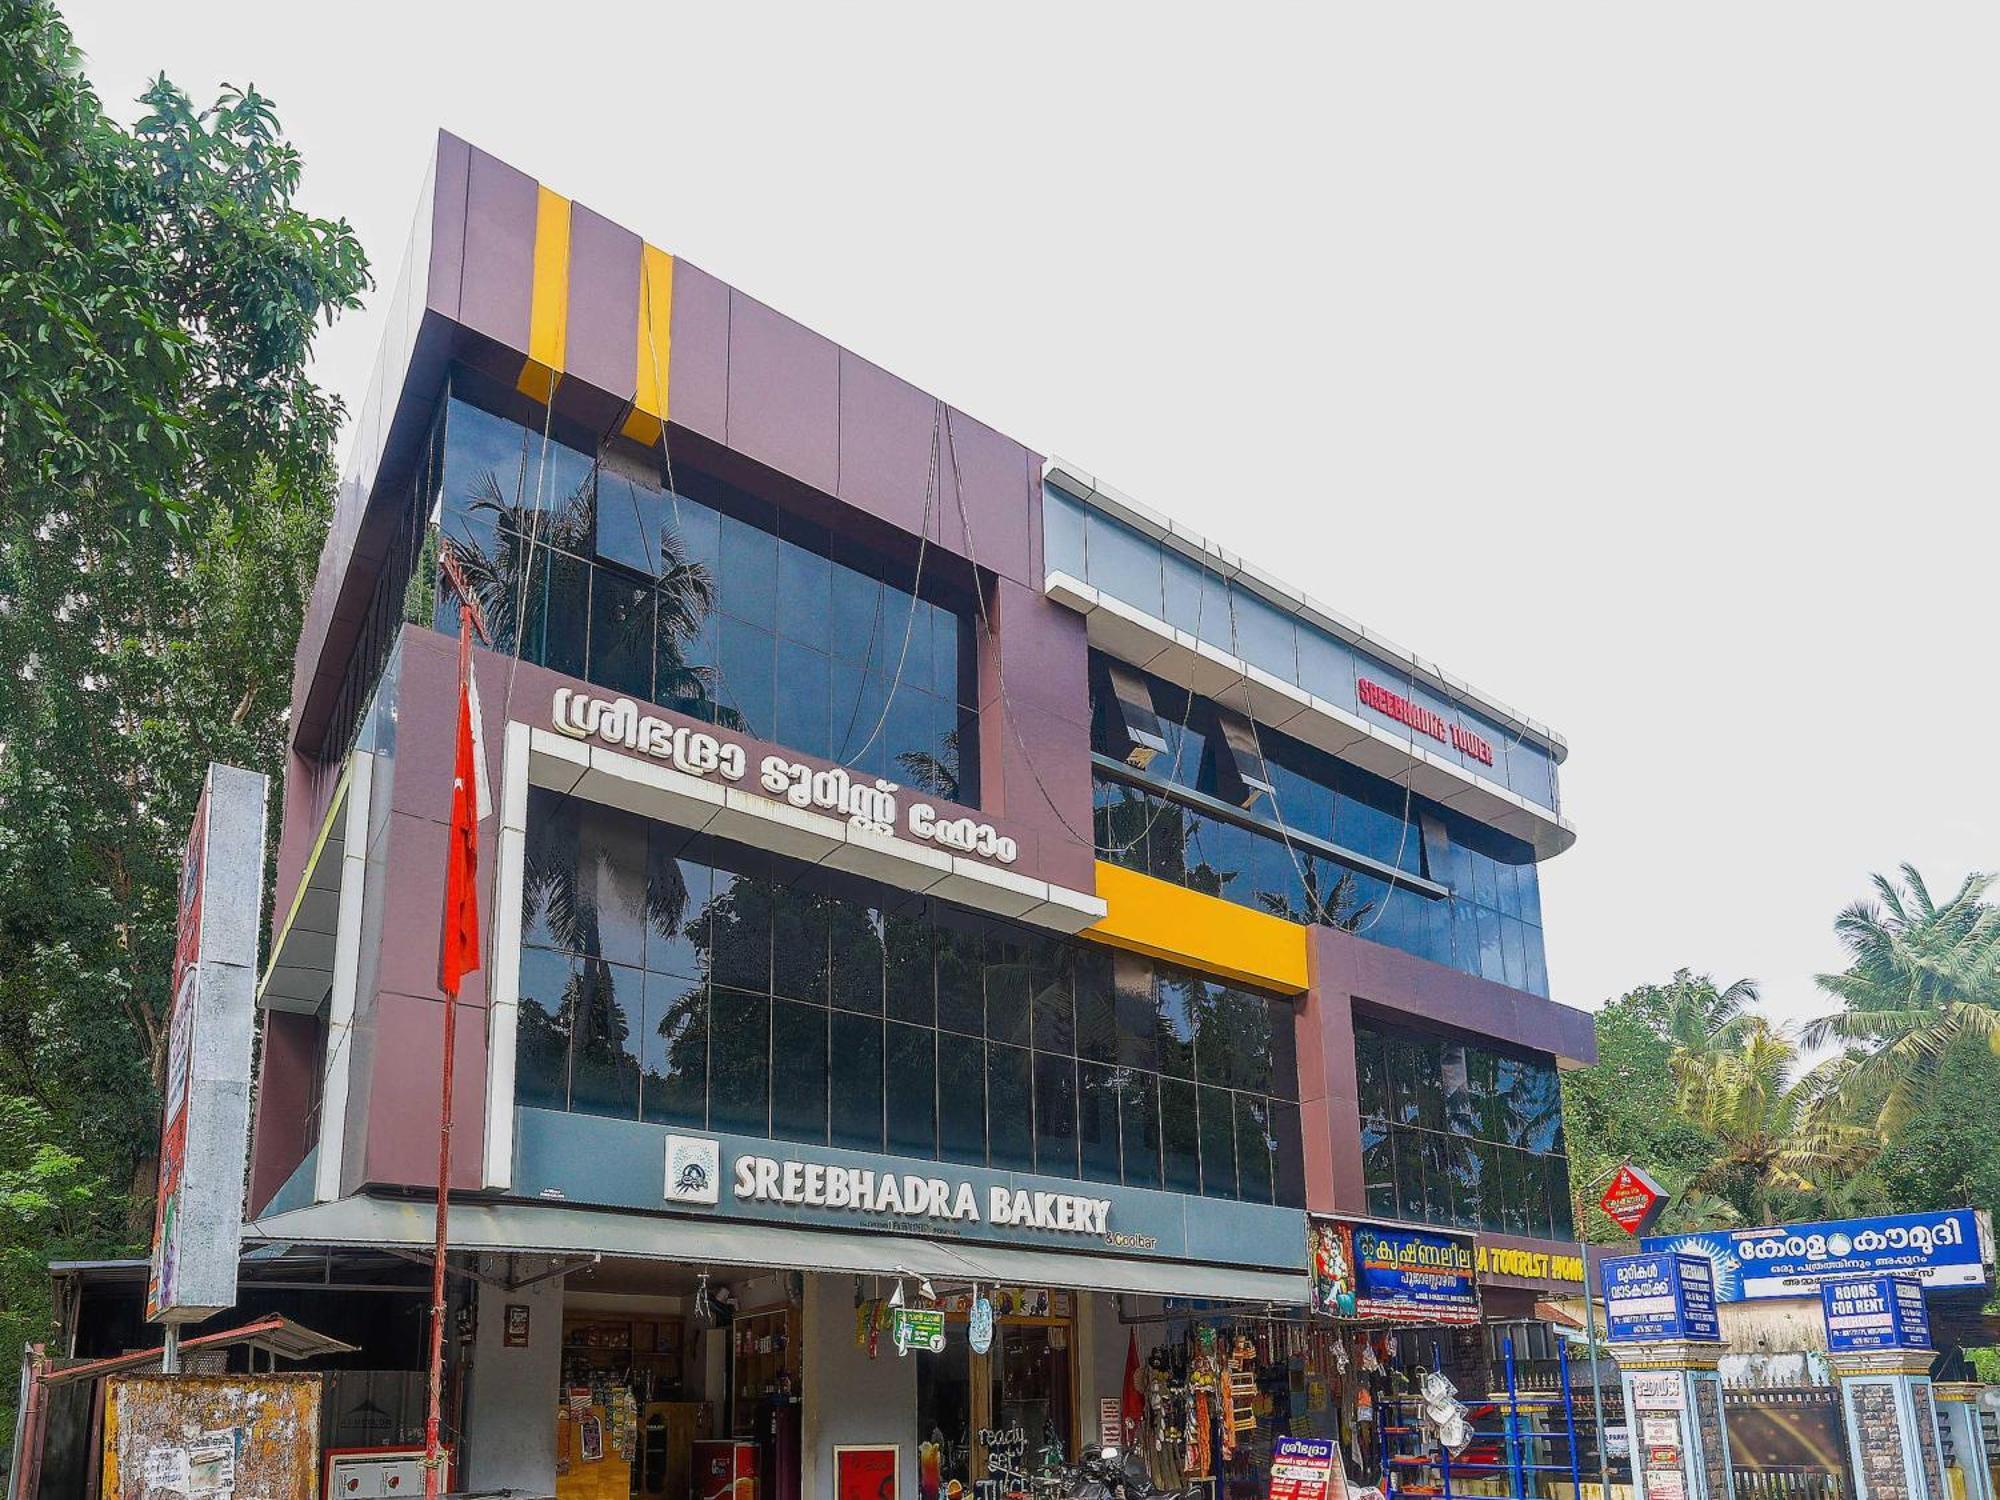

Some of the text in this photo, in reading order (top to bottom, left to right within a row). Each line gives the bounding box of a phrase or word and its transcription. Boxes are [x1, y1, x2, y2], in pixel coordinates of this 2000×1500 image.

[908, 803, 1018, 863] ഹോം
[733, 1153, 1112, 1236] SREEBHADRA BAKERY
[1738, 1218, 1964, 1260] കേരള കൗമുദി
[1490, 1248, 1549, 1279] TOURIST
[1832, 1300, 1854, 1315] FOR
[1855, 1298, 1886, 1313] RENT
[1835, 1284, 1878, 1300] ROOMS
